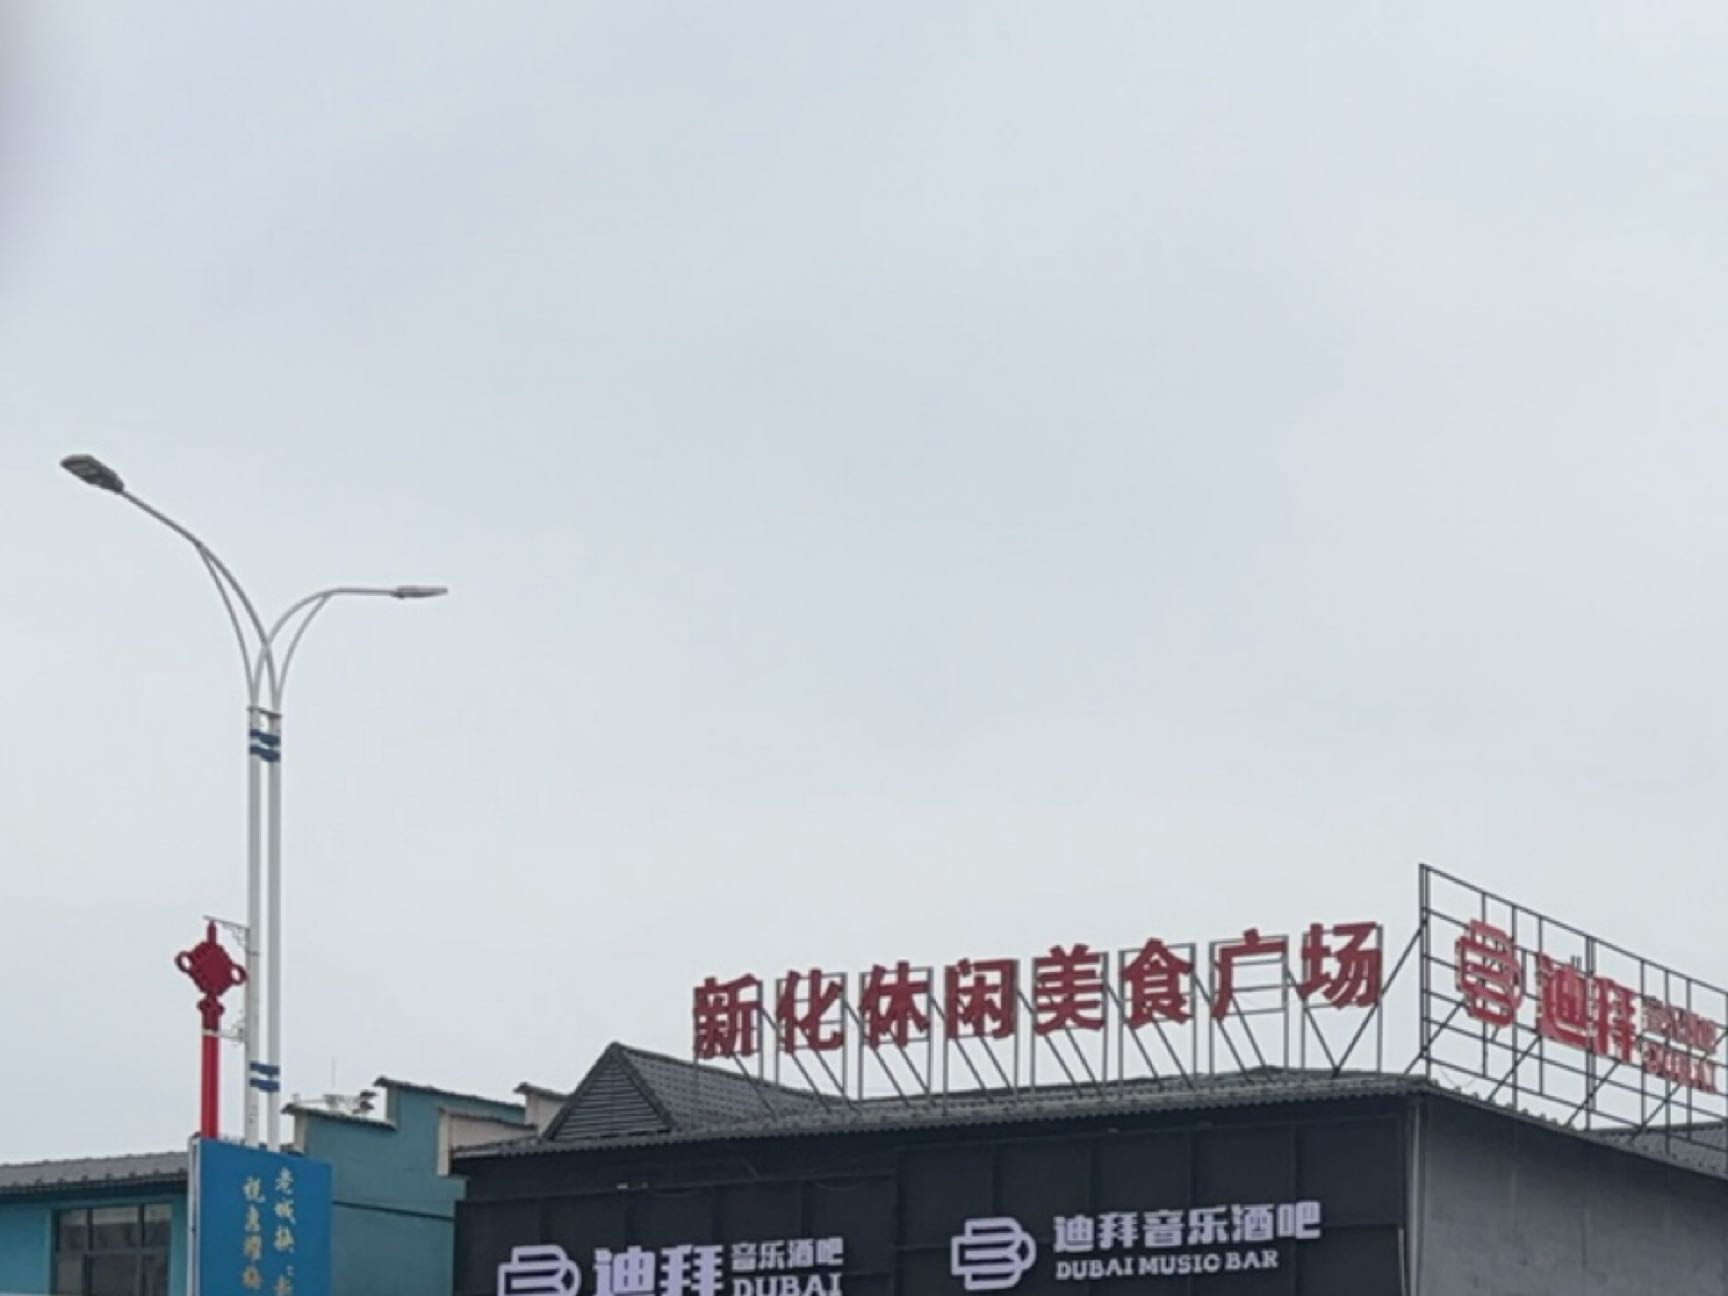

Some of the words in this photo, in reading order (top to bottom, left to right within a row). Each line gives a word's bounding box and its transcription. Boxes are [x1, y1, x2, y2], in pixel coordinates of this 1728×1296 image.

[692, 921, 1384, 1060] 新化休闲美食广场
[1052, 1201, 1322, 1253] 迪拜音乐酒吧
[731, 1236, 845, 1272] 音乐酒吧
[1056, 1257, 1134, 1280] DUBAI
[1139, 1252, 1222, 1276] MUSIC
[1225, 1249, 1280, 1271] BAR
